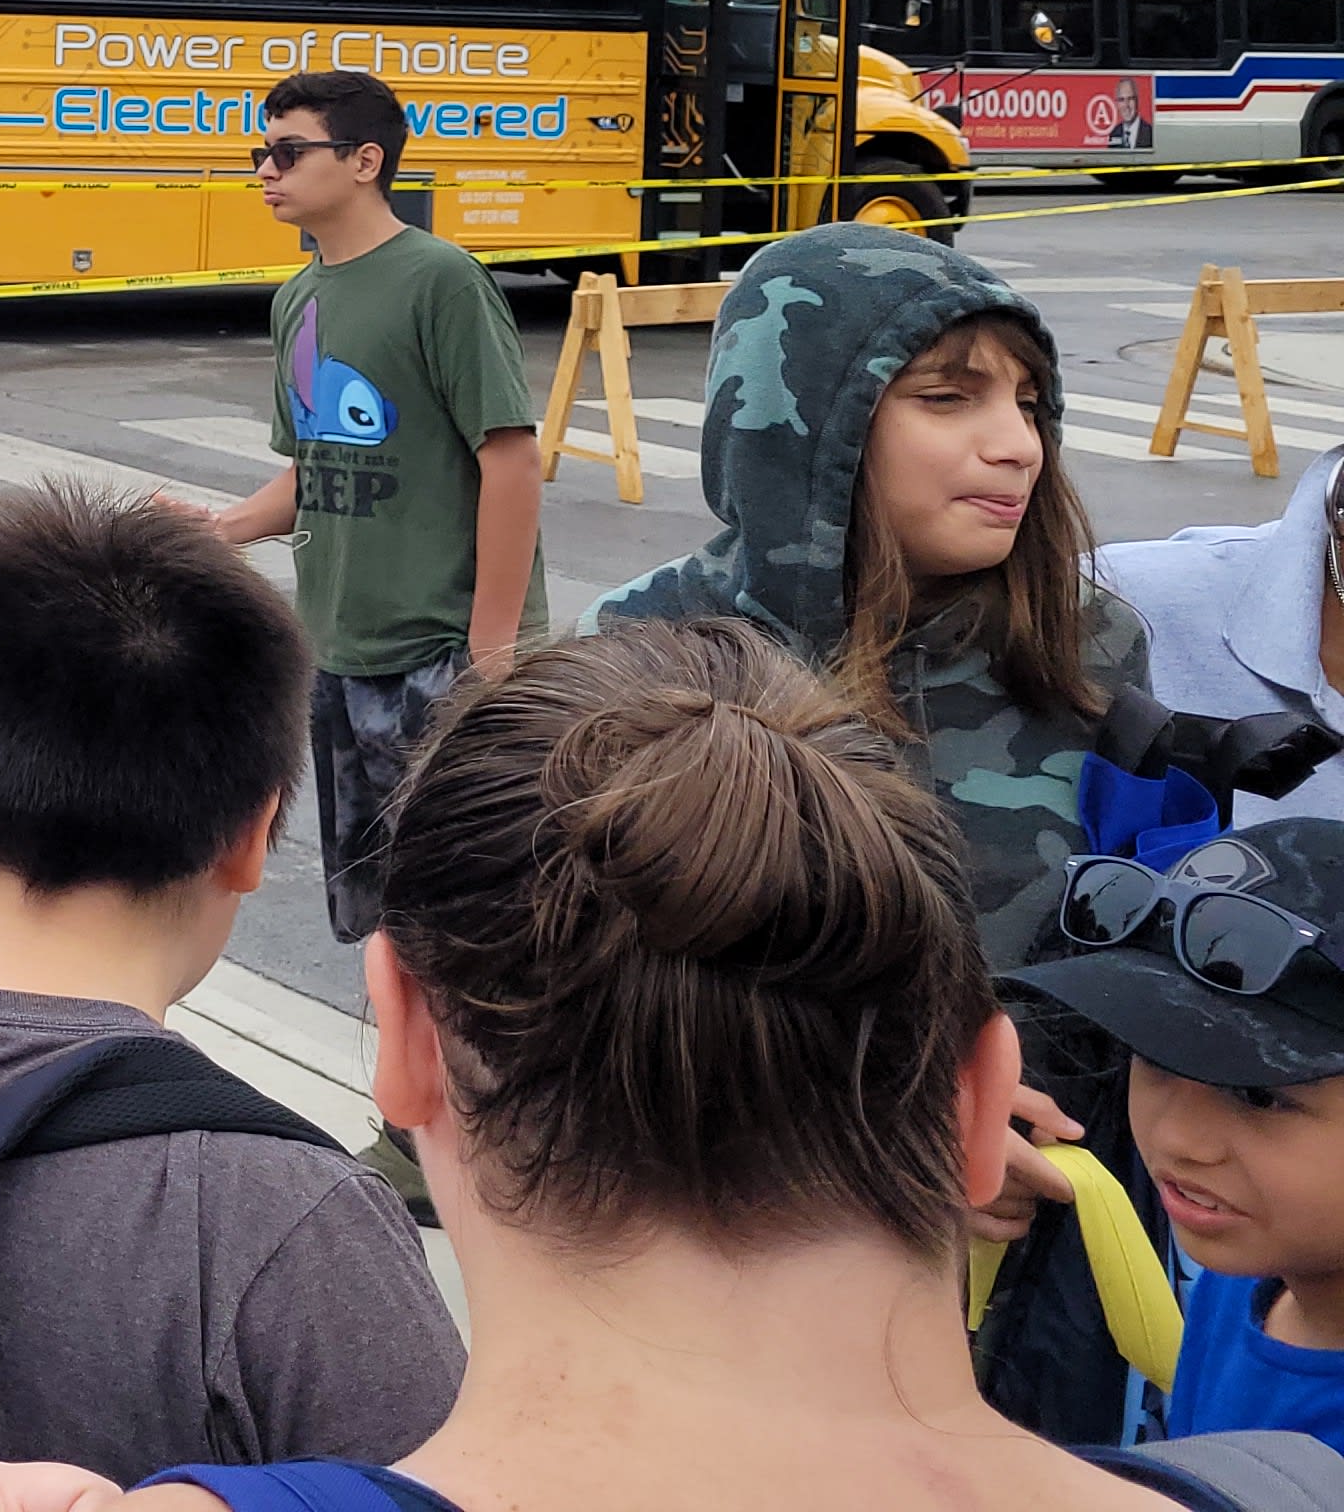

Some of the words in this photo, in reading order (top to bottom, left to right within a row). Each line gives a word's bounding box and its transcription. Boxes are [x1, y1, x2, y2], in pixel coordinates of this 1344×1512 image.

[54, 23, 246, 70] Power
[261, 30, 317, 74] of
[331, 31, 531, 77] Choice
[52, 87, 267, 135] Electri
[405, 95, 568, 140] wered
[295, 465, 400, 518] EEP
